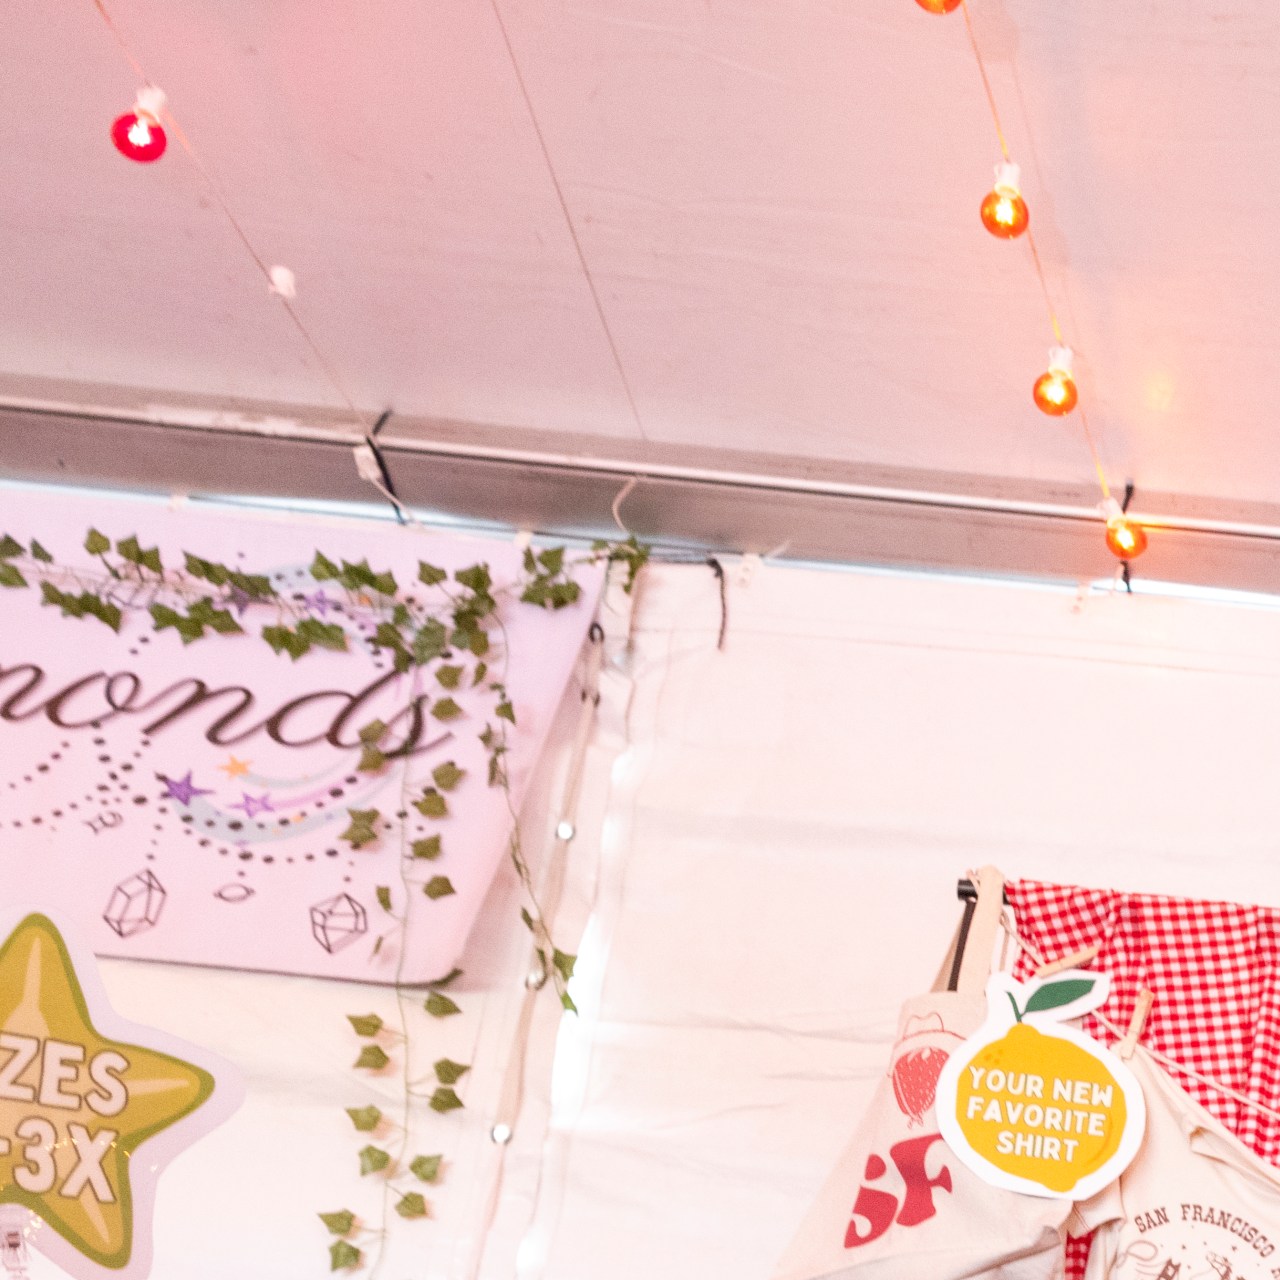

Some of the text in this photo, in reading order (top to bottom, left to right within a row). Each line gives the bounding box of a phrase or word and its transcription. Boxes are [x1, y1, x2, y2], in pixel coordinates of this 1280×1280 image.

[968, 1065, 1113, 1108] YOUR NEW
[966, 1095, 1107, 1137] FAVORITE
[995, 1130, 1079, 1163] SHIRT
[1134, 1205, 1171, 1234] SAN
[1181, 1203, 1276, 1258] FRANCISCO
